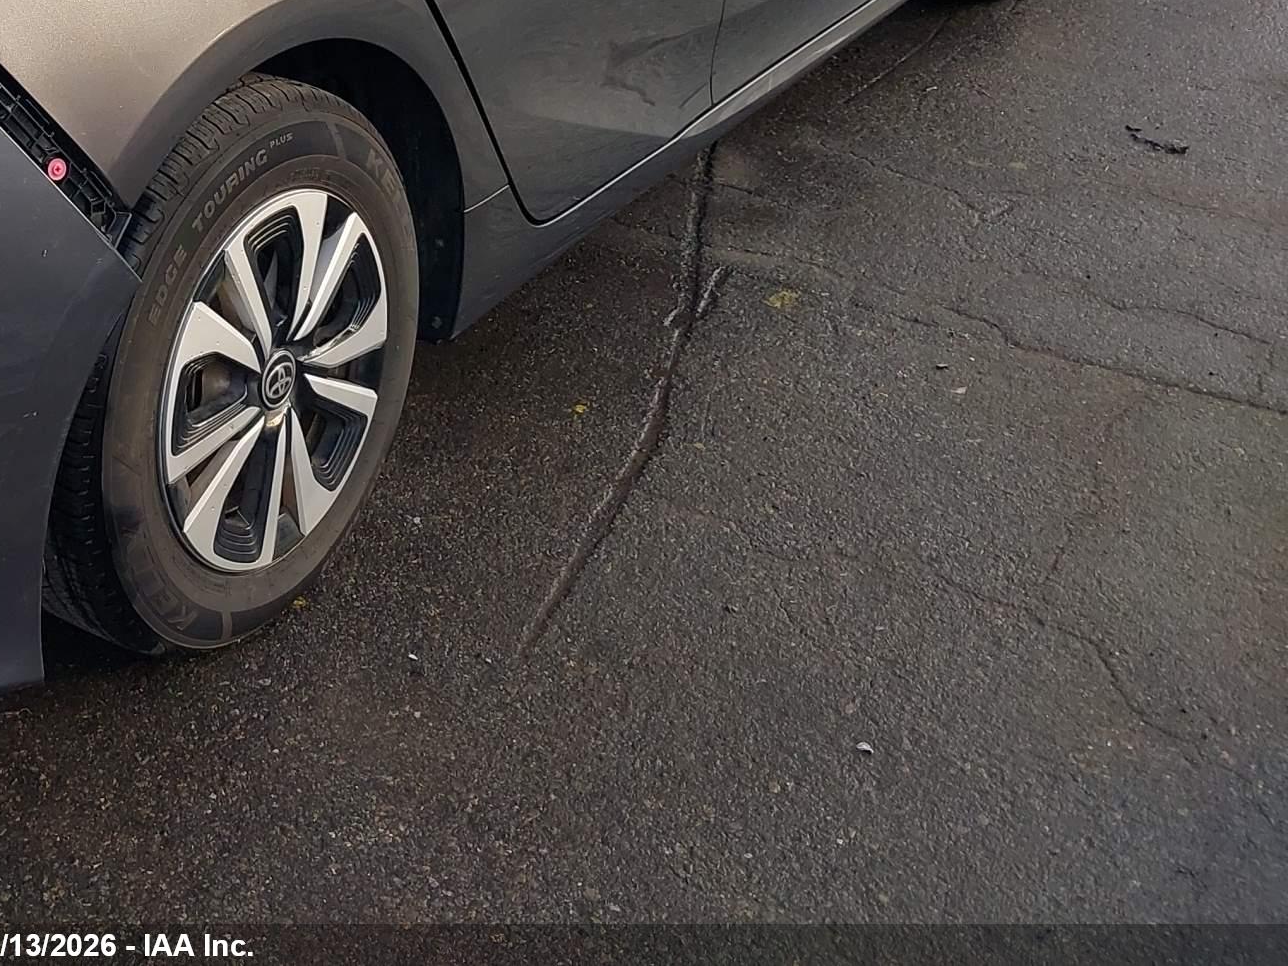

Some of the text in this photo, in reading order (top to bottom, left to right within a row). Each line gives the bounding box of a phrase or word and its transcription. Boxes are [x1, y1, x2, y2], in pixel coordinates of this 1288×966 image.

[148, 132, 294, 326] EDGE TOURING PLUS
